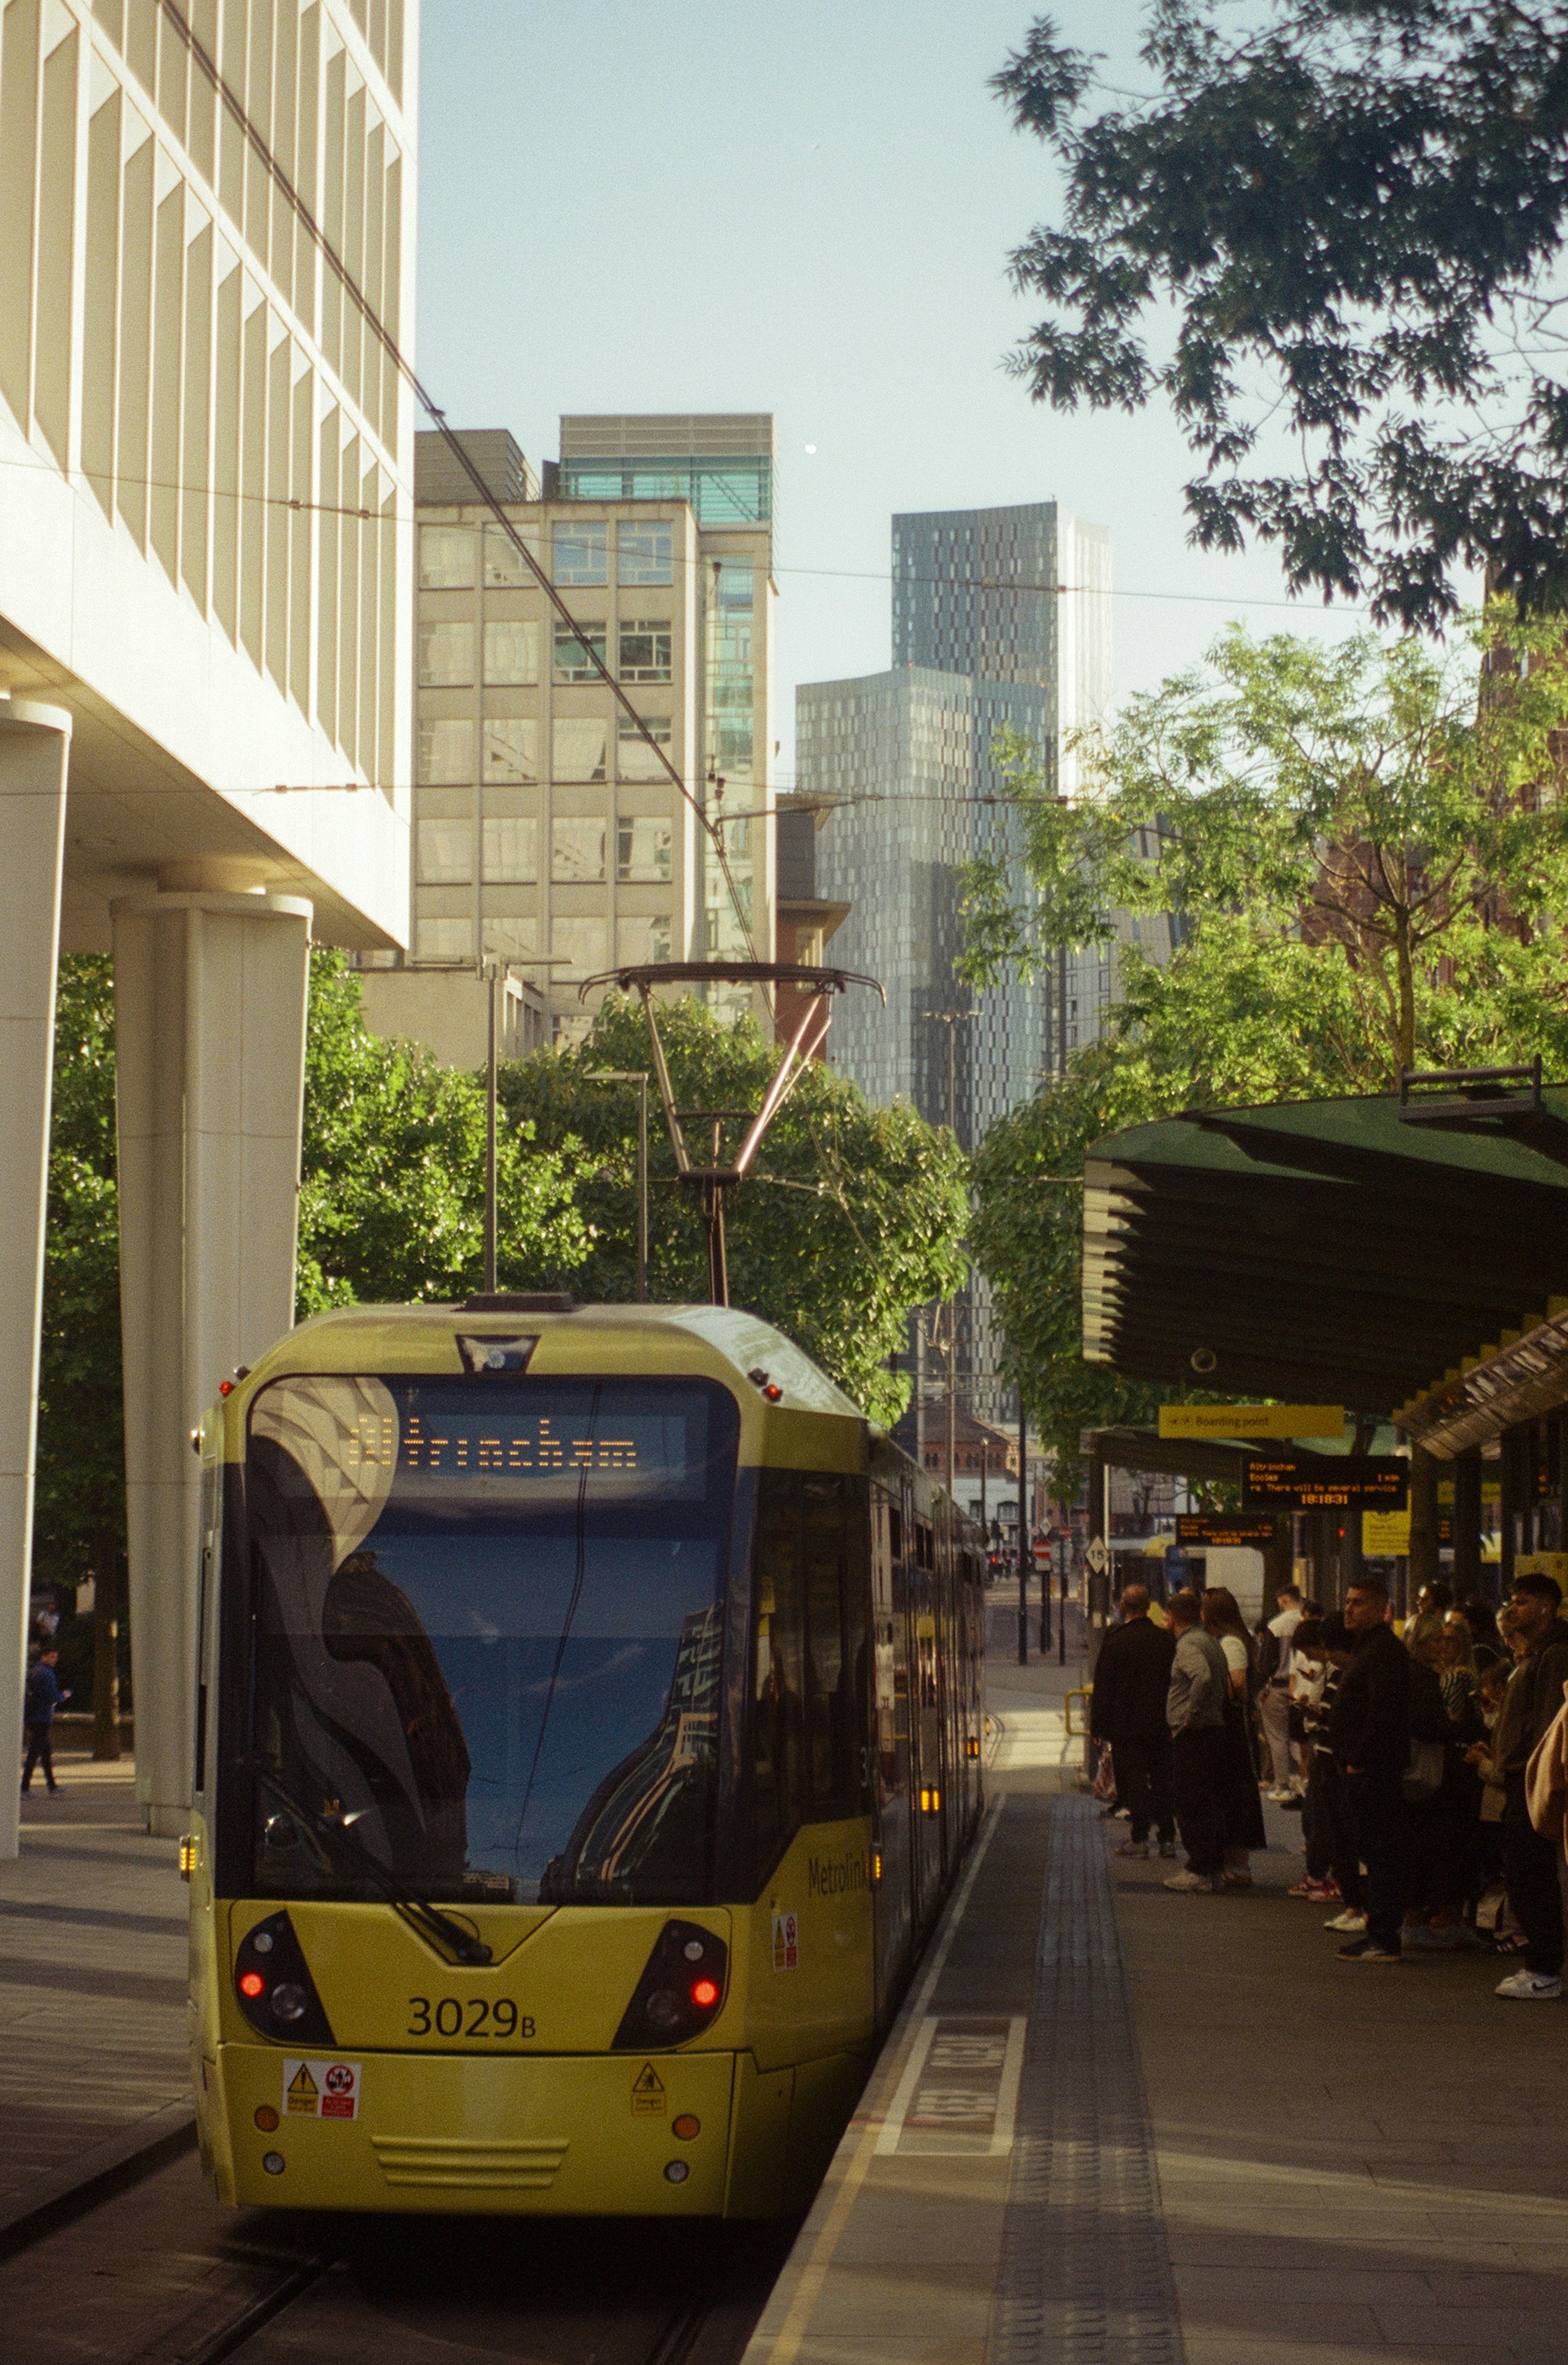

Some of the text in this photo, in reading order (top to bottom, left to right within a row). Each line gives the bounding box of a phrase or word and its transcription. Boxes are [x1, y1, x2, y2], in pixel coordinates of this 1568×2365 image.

[1196, 1416, 1269, 1429] Boarding point
[1266, 1483, 1291, 1492] There
